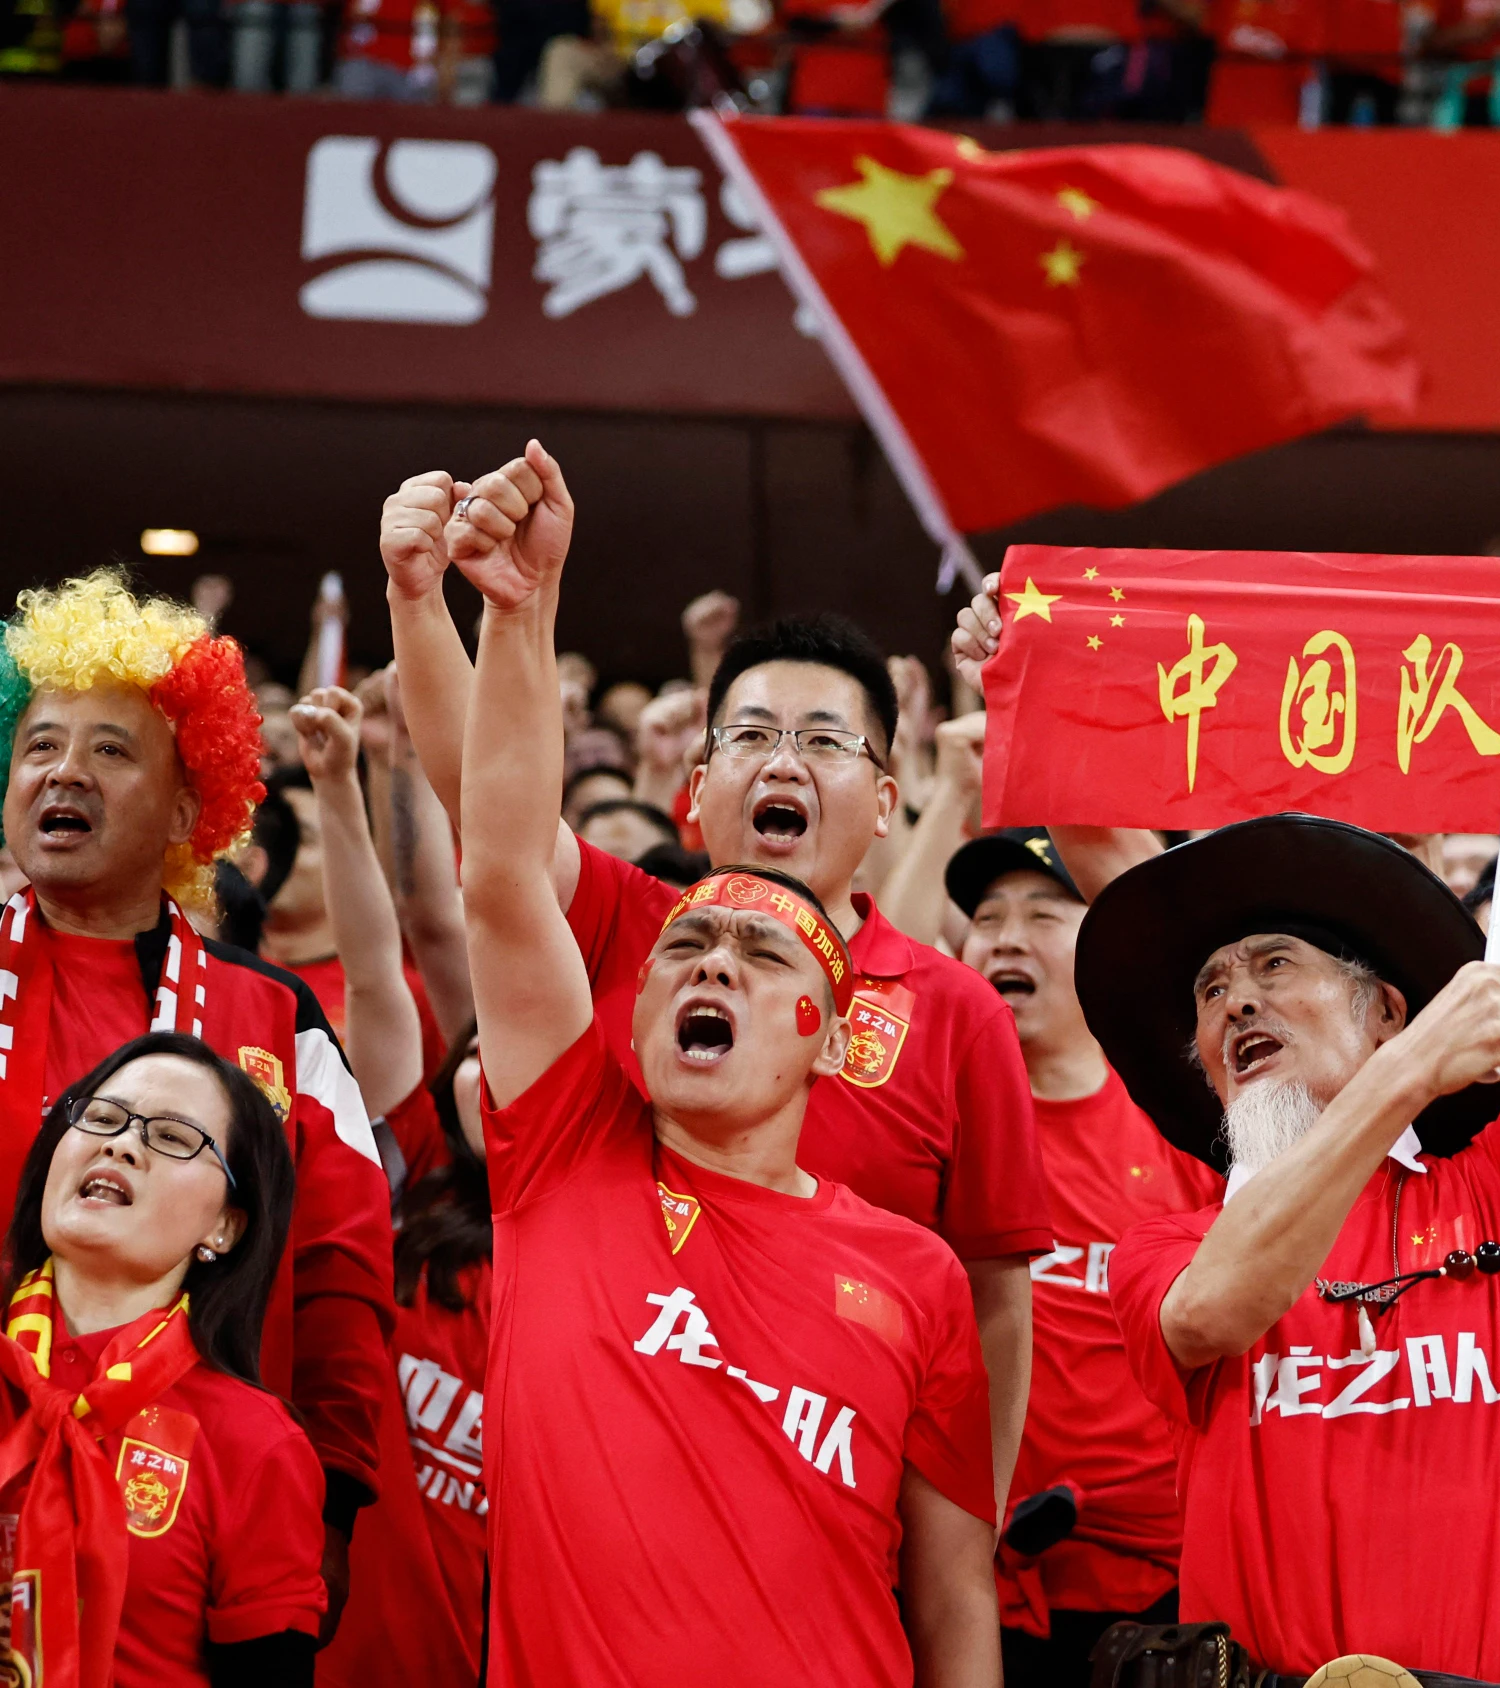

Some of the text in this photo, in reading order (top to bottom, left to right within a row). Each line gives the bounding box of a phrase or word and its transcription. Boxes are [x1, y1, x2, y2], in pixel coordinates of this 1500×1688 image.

[769, 893, 845, 985] 中国加油
[856, 1009, 896, 1038] 龙之队
[657, 1189, 690, 1217] 之队
[130, 1449, 178, 1475] 龙之队
